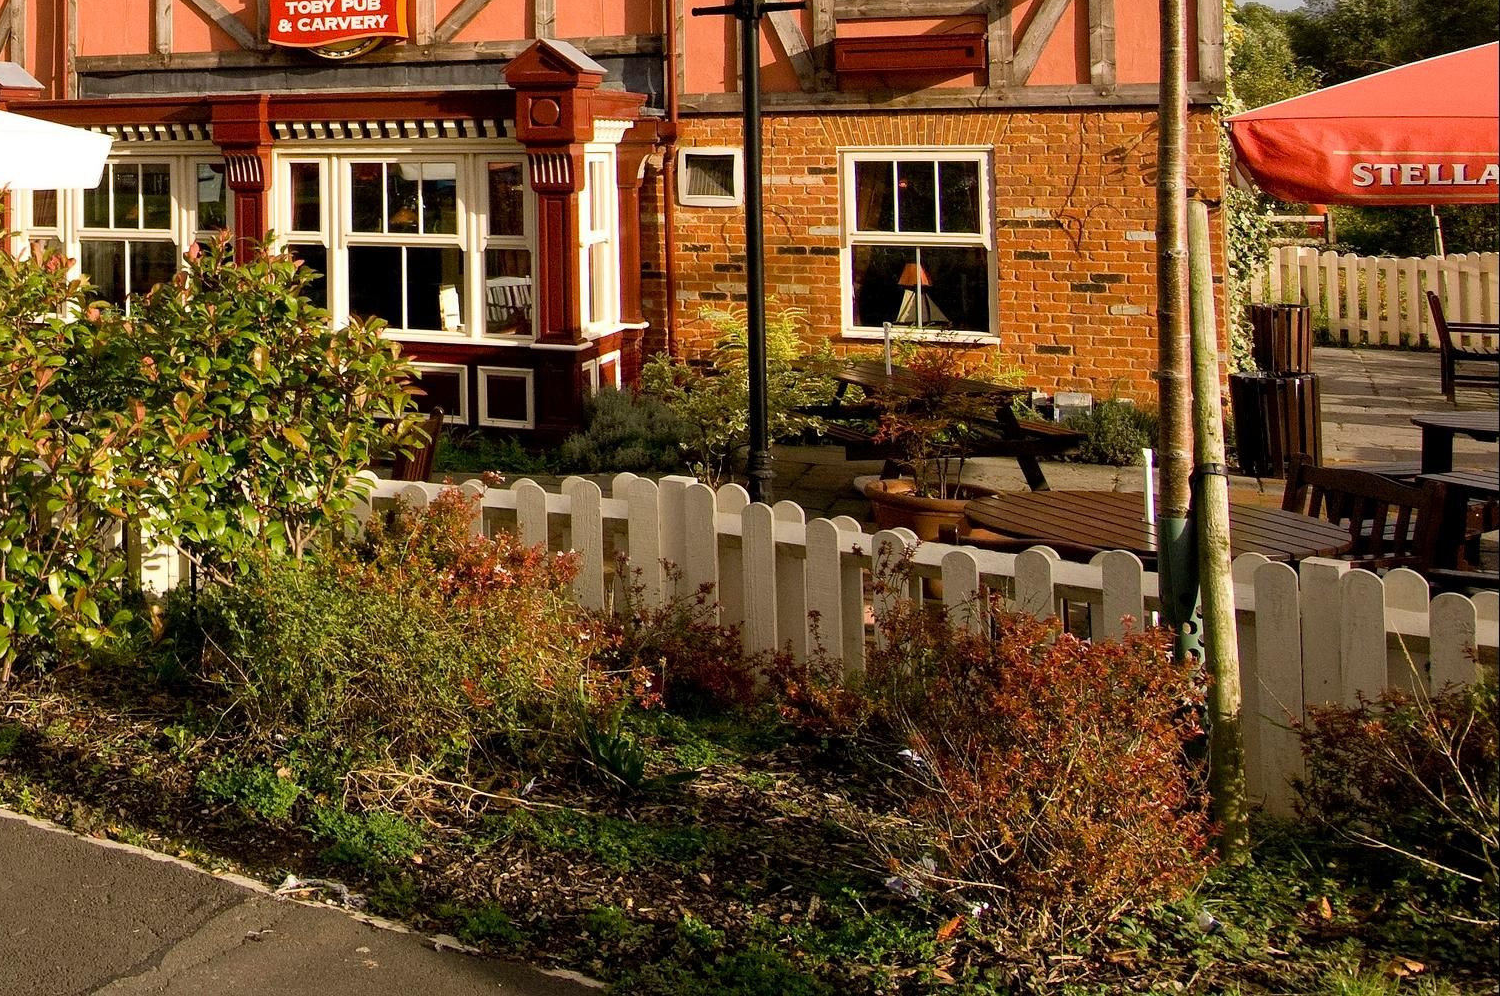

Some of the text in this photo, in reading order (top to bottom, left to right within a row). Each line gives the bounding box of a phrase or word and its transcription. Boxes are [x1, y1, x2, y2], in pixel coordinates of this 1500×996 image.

[277, 14, 389, 33] & CARVERY
[1352, 162, 1499, 186] STELLA
